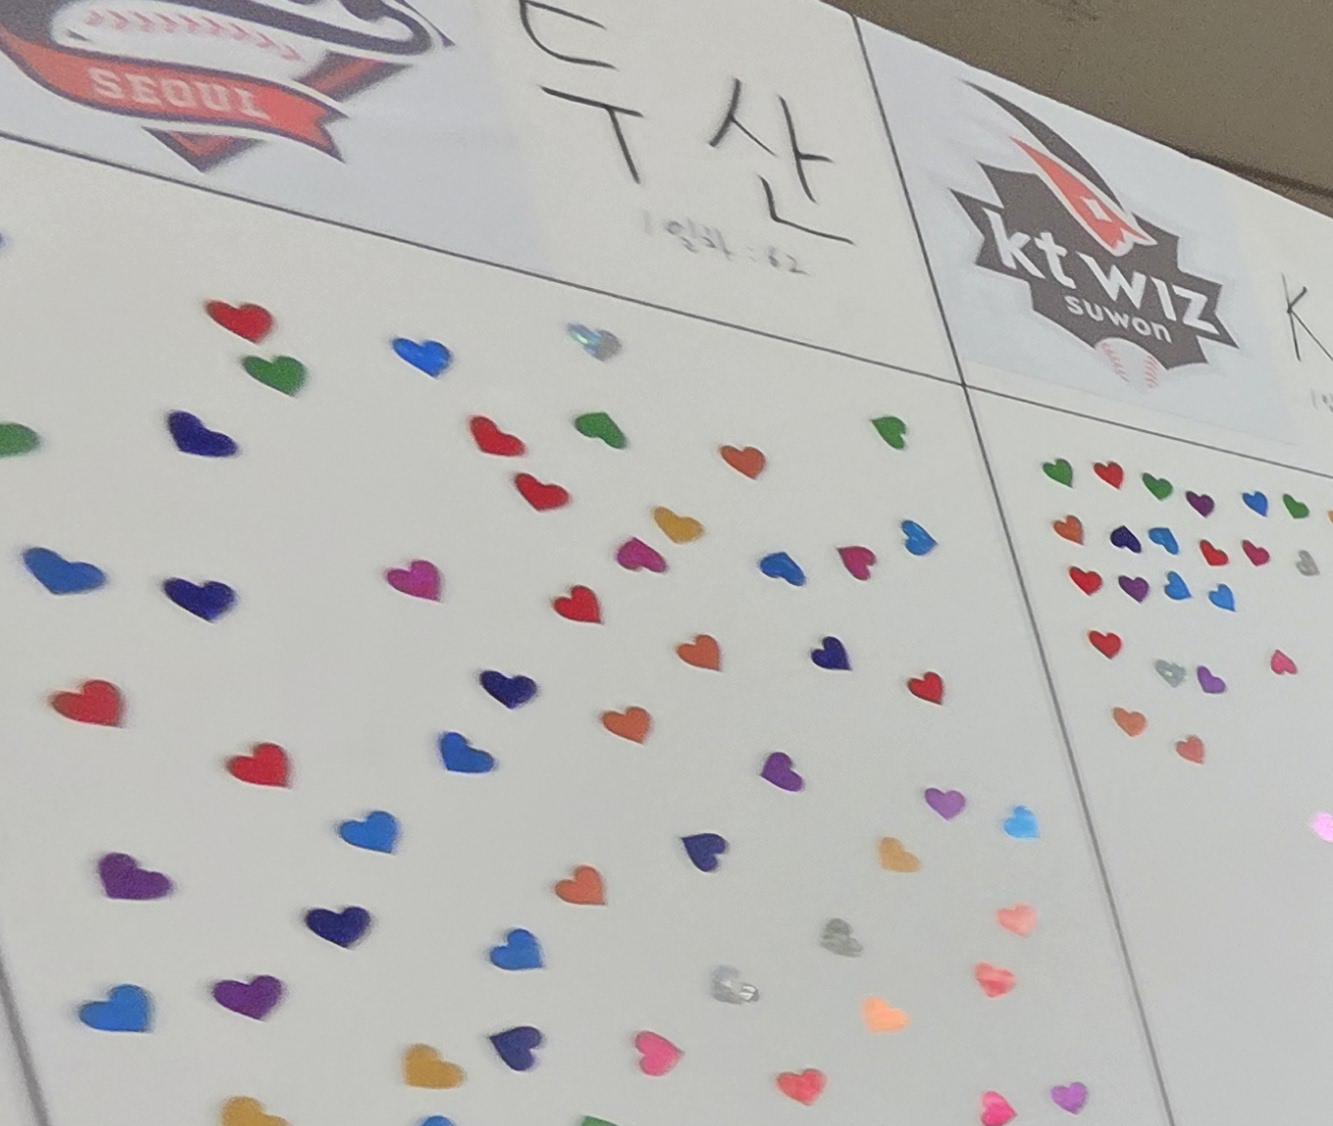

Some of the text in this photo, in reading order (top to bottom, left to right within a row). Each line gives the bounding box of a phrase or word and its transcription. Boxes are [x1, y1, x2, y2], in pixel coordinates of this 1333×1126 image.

[86, 66, 272, 121] SEOUL
[519, 0, 856, 246] 두산
[983, 207, 1077, 290] kt
